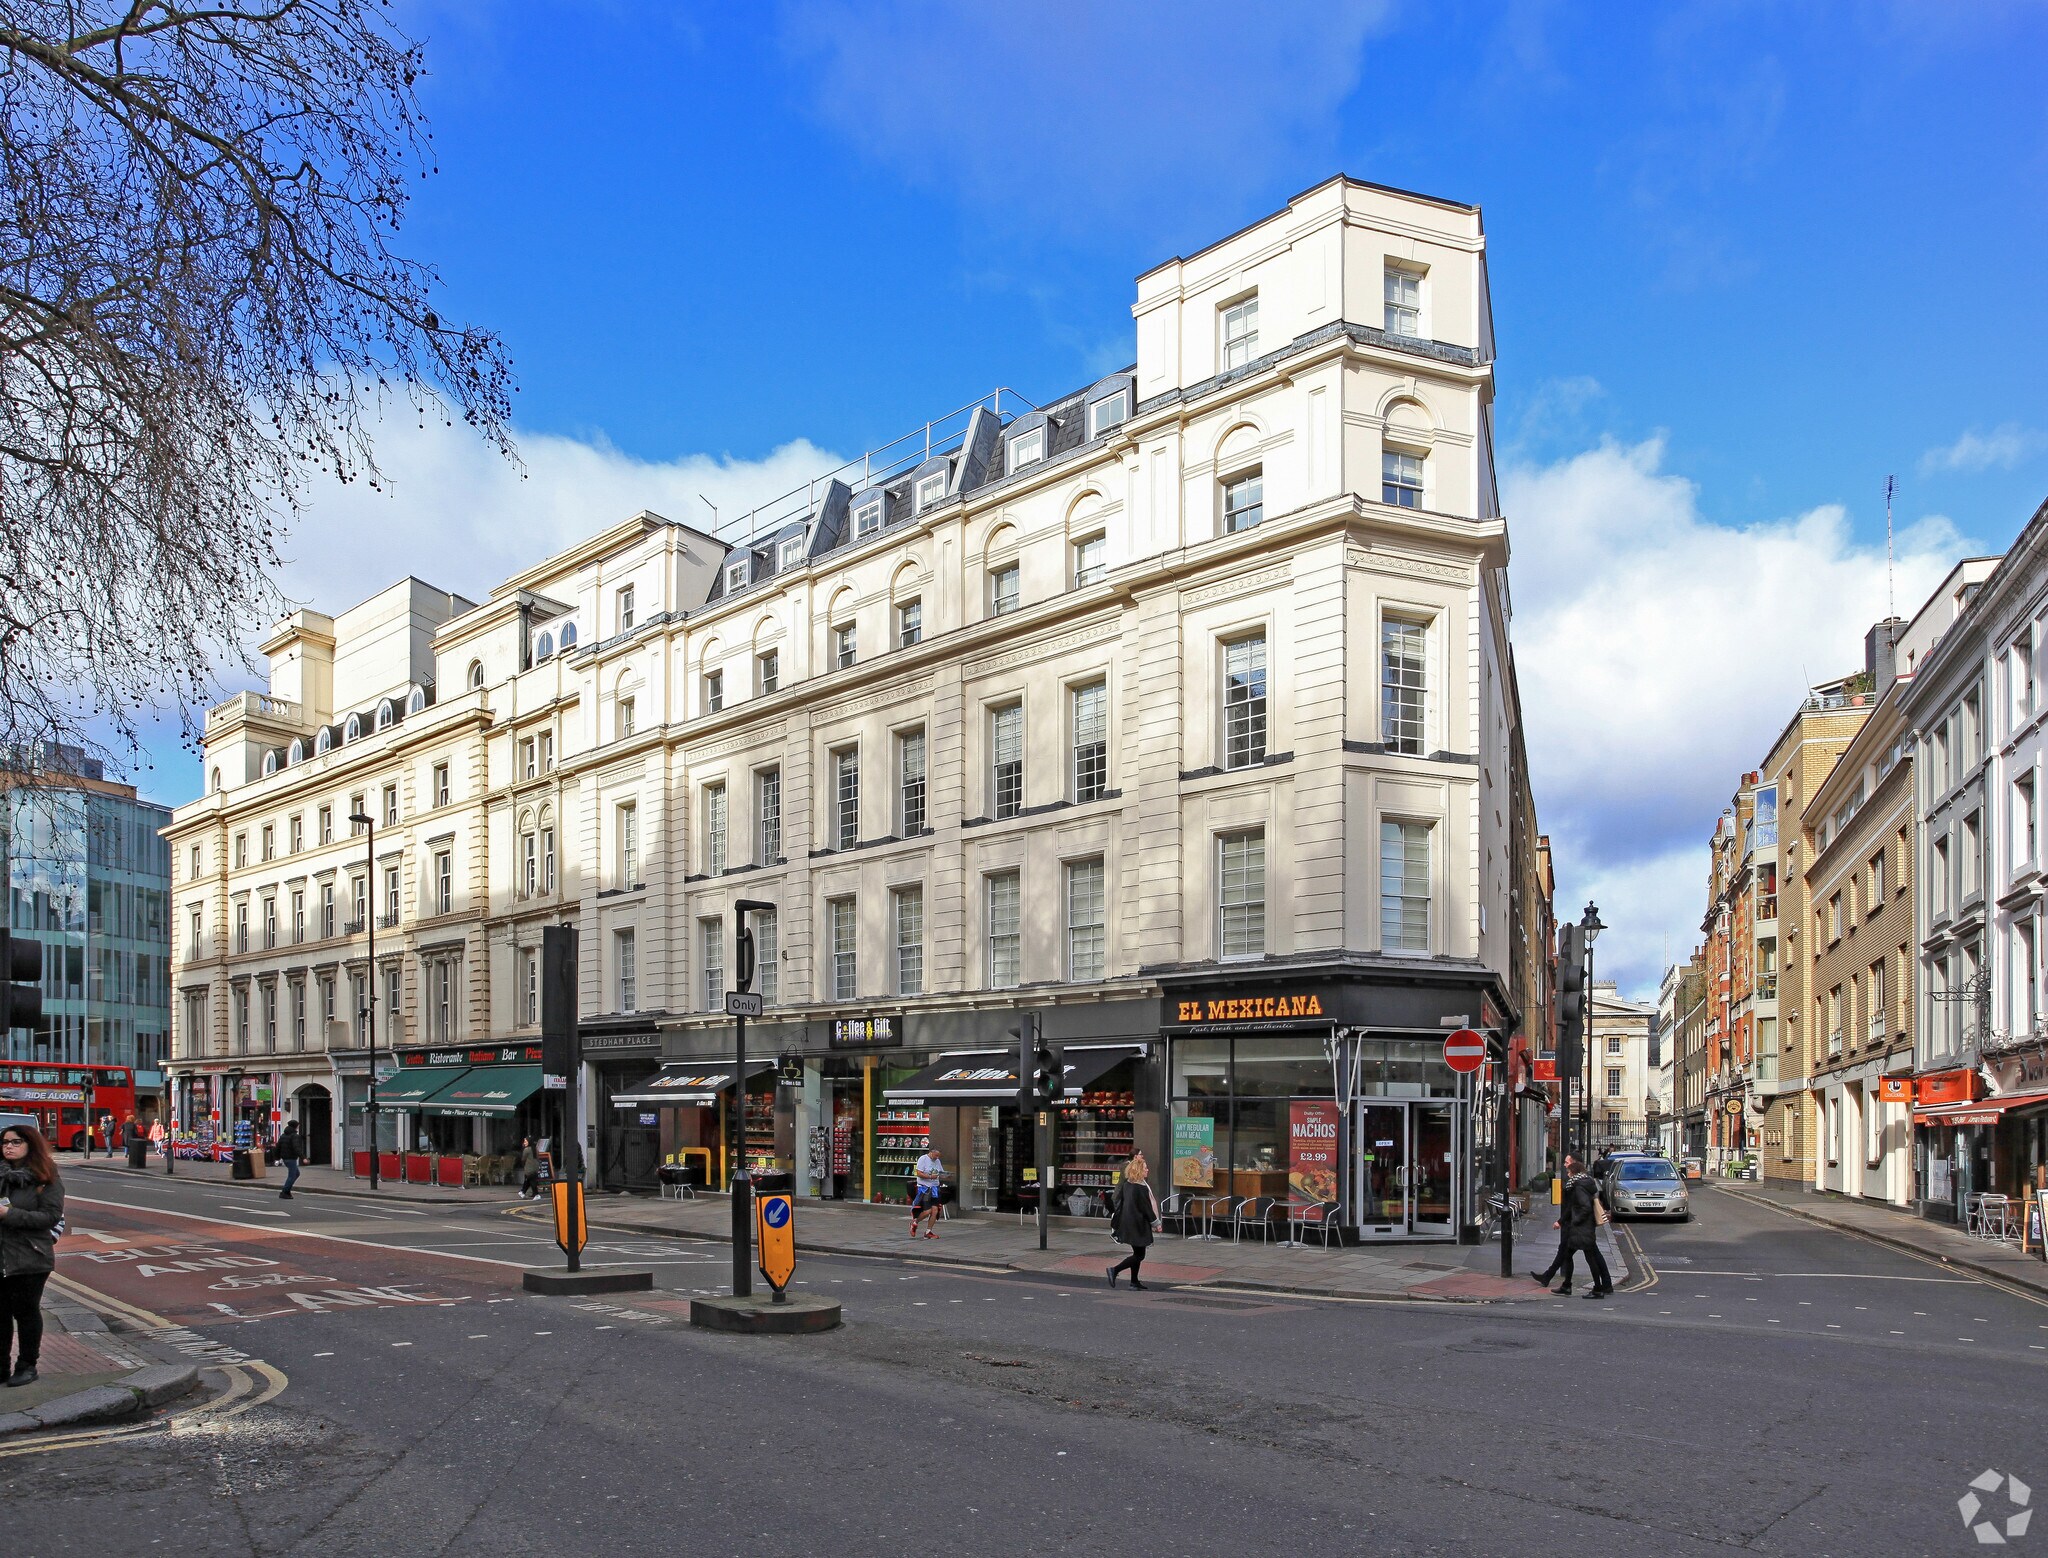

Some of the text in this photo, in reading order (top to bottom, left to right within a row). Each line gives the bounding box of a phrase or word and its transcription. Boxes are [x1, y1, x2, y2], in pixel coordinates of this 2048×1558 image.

[732, 999, 757, 1012] Only
[1178, 995, 1323, 1021] EL MEXICANA
[874, 1017, 891, 1033] Gift
[589, 1035, 651, 1047] STEDHAM PLACE
[429, 1051, 464, 1064] Ristorante
[501, 1048, 518, 1061] Bar
[938, 1068, 1012, 1081] Coffee
[25, 1091, 48, 1099] RIDE
[48, 1092, 79, 1101] ALONG
[1176, 1131, 1202, 1139] MAIN MEAL
[1187, 1124, 1210, 1132] REGULAR
[1292, 1123, 1336, 1138] NACHOS
[1300, 1152, 1327, 1161] £2.99
[82, 1244, 226, 1264] BUS
[135, 1255, 281, 1278] AND
[206, 1283, 473, 1319] LANE
